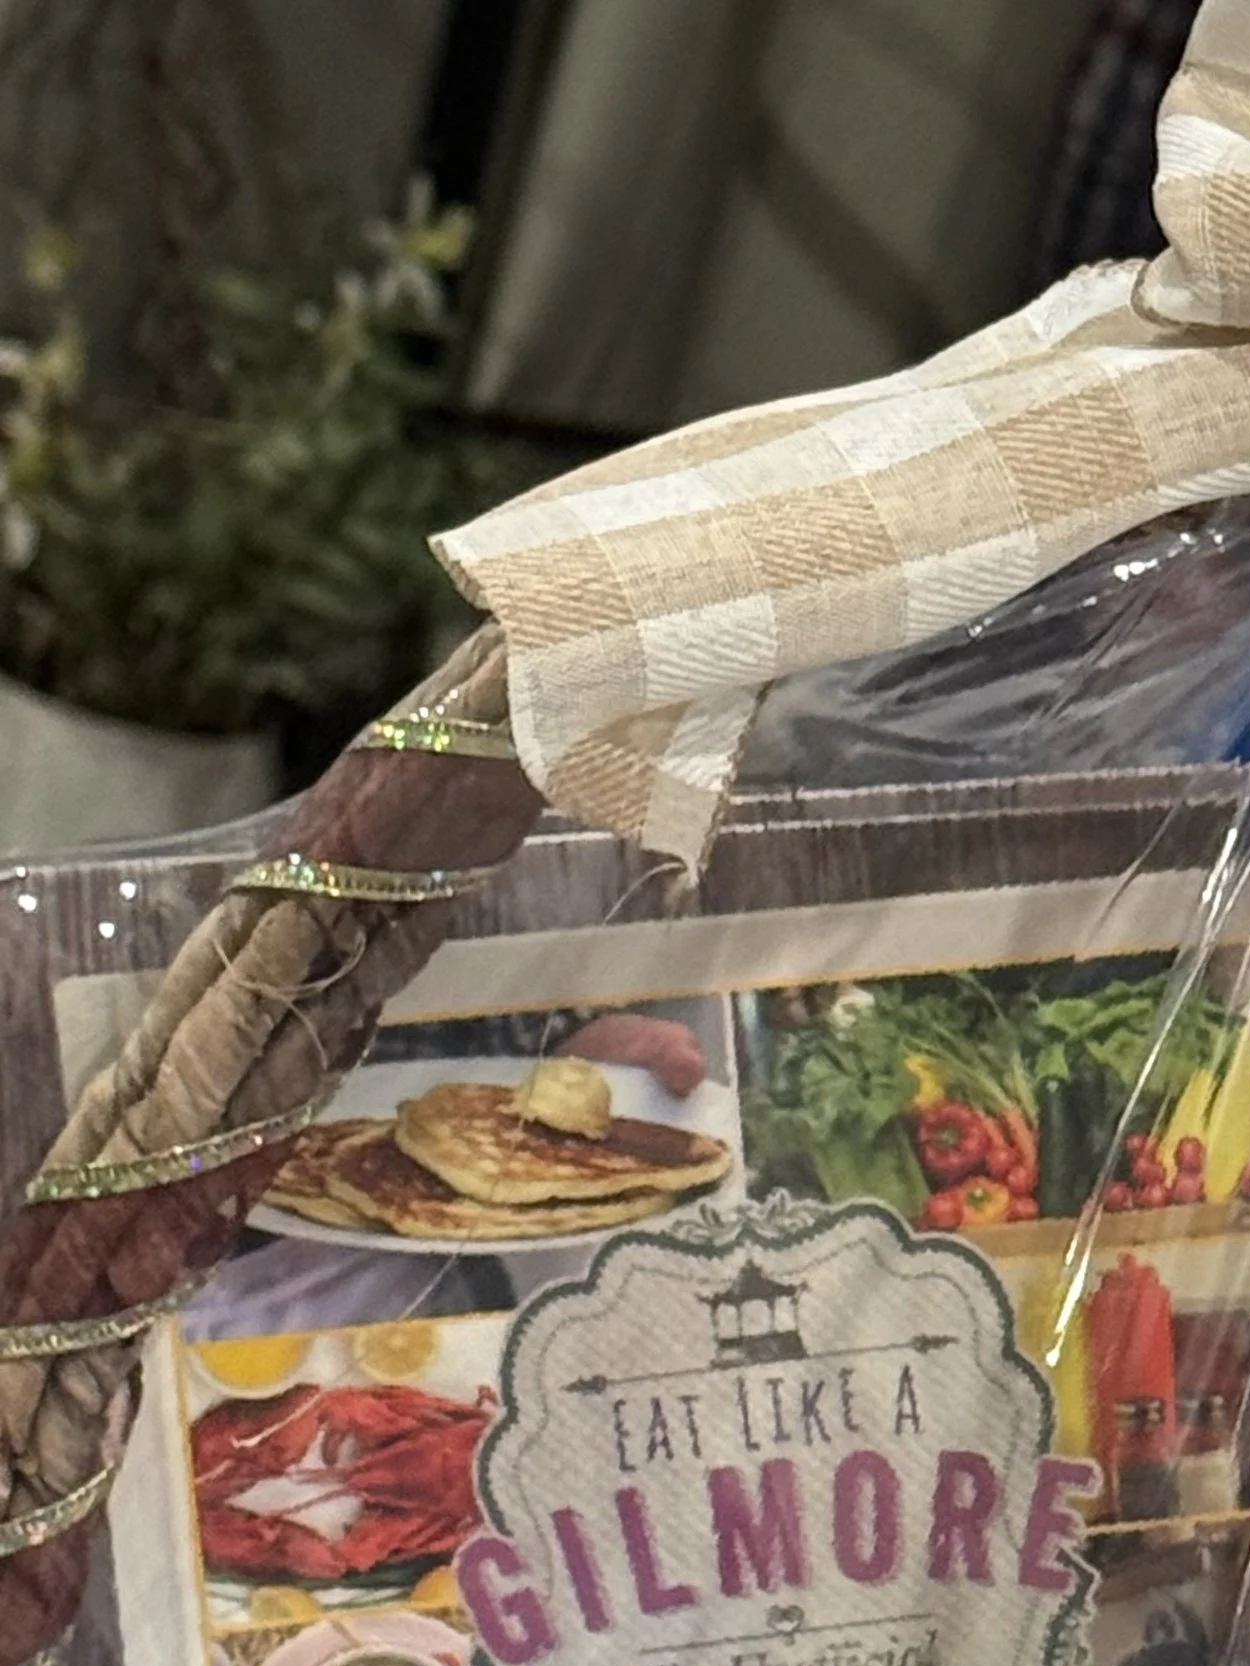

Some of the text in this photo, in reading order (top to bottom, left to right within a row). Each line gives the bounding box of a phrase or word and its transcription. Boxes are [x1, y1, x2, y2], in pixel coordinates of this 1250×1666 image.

[612, 1365, 923, 1473] EAT LIKE A
[455, 1448, 1098, 1666] GILMORE
